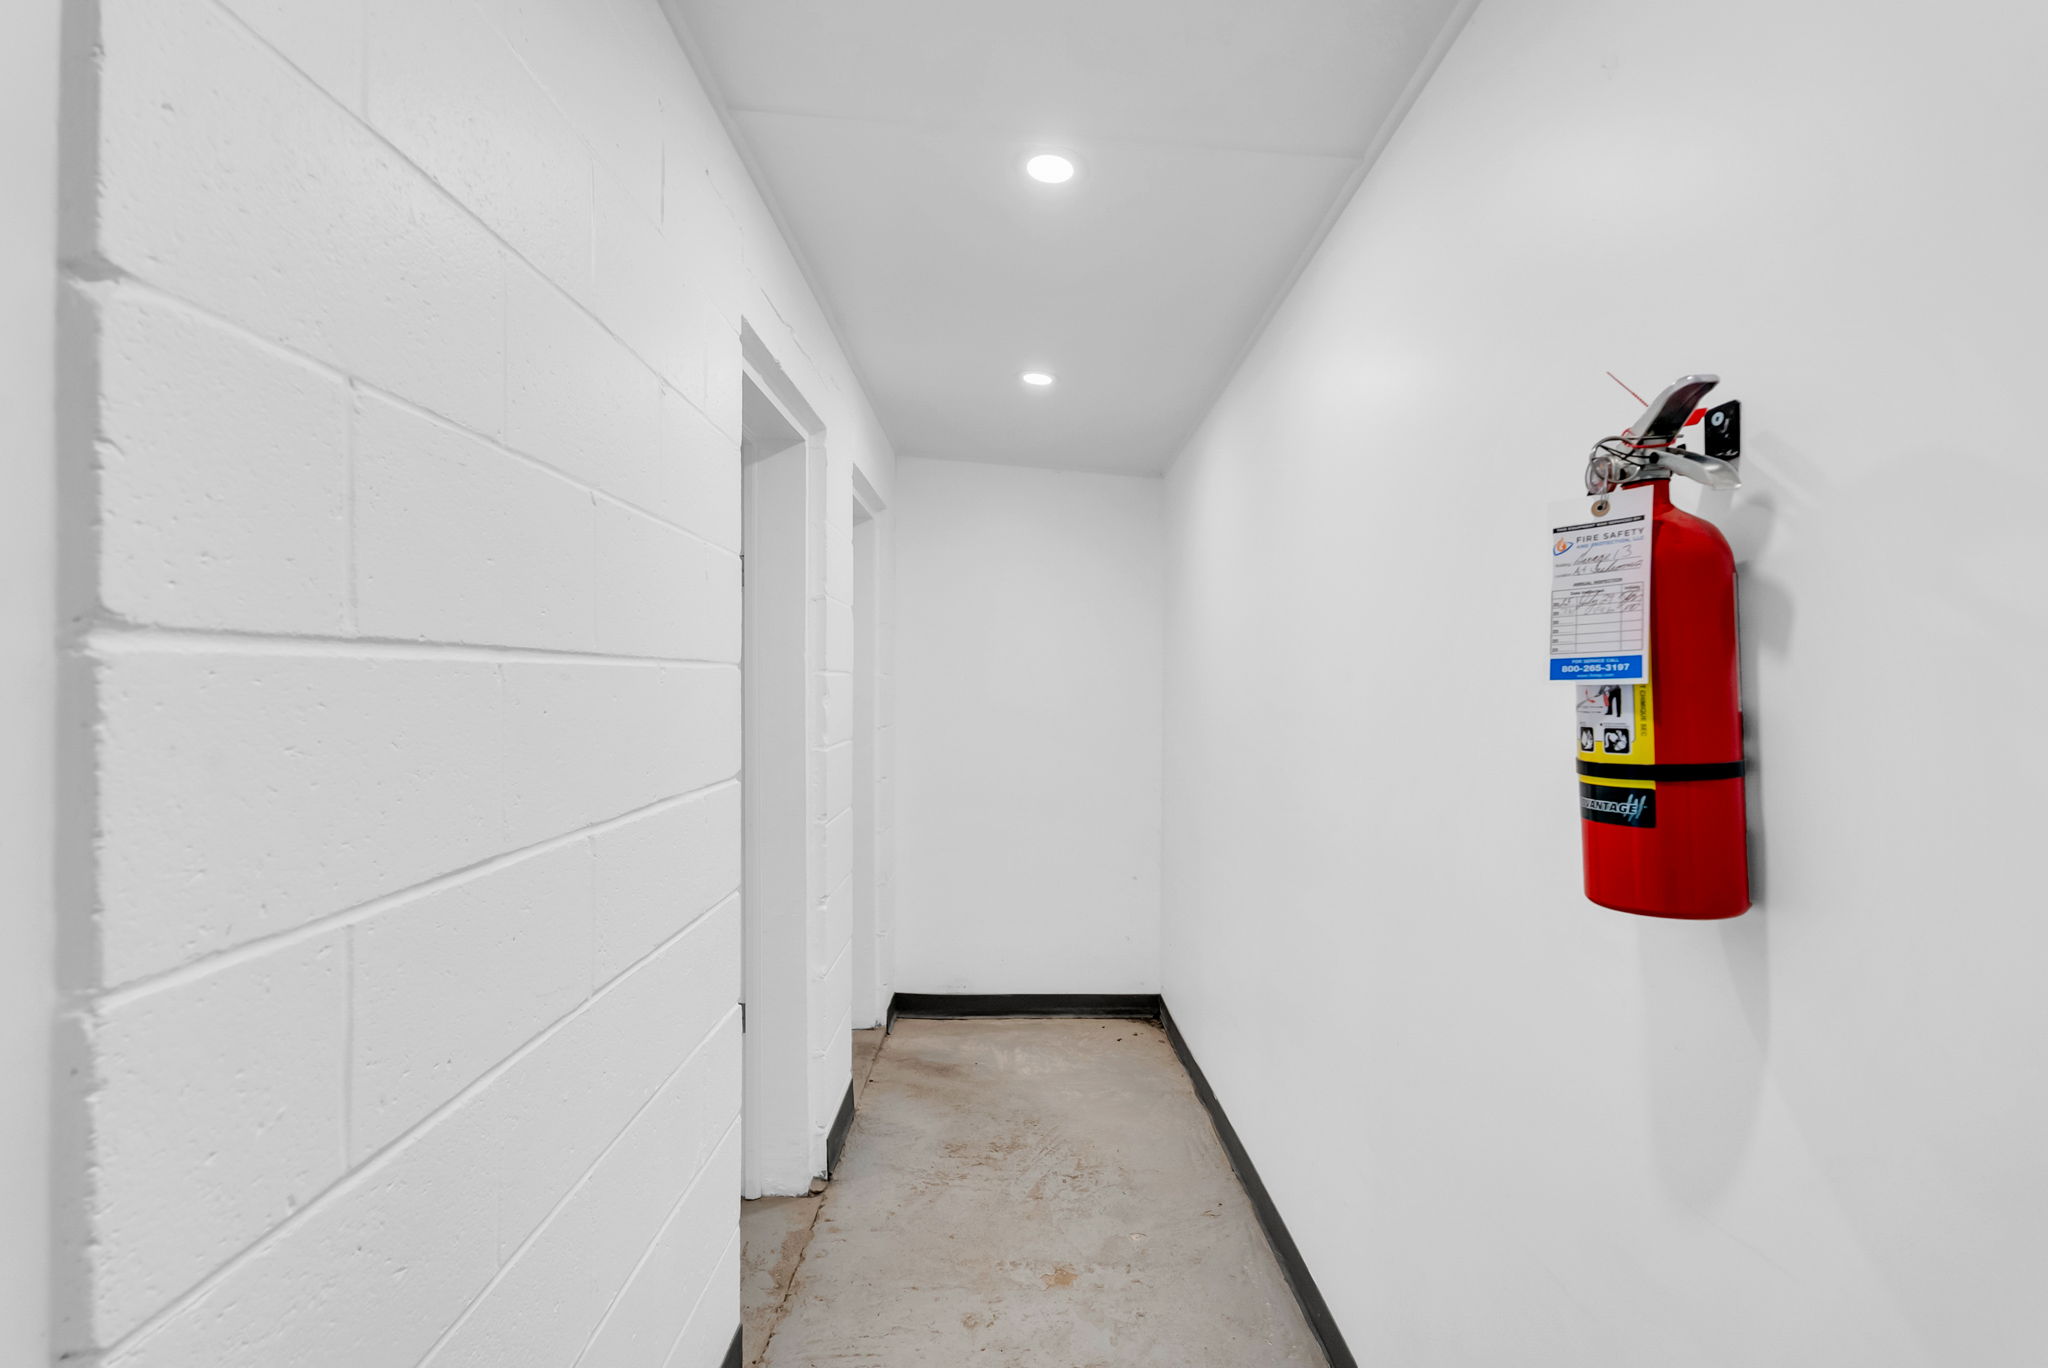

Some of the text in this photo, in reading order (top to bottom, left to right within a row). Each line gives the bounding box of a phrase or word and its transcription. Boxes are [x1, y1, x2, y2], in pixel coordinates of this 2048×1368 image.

[1576, 528, 1644, 543] FIRE SAFETY
[1561, 663, 1631, 673] 800-265-3197
